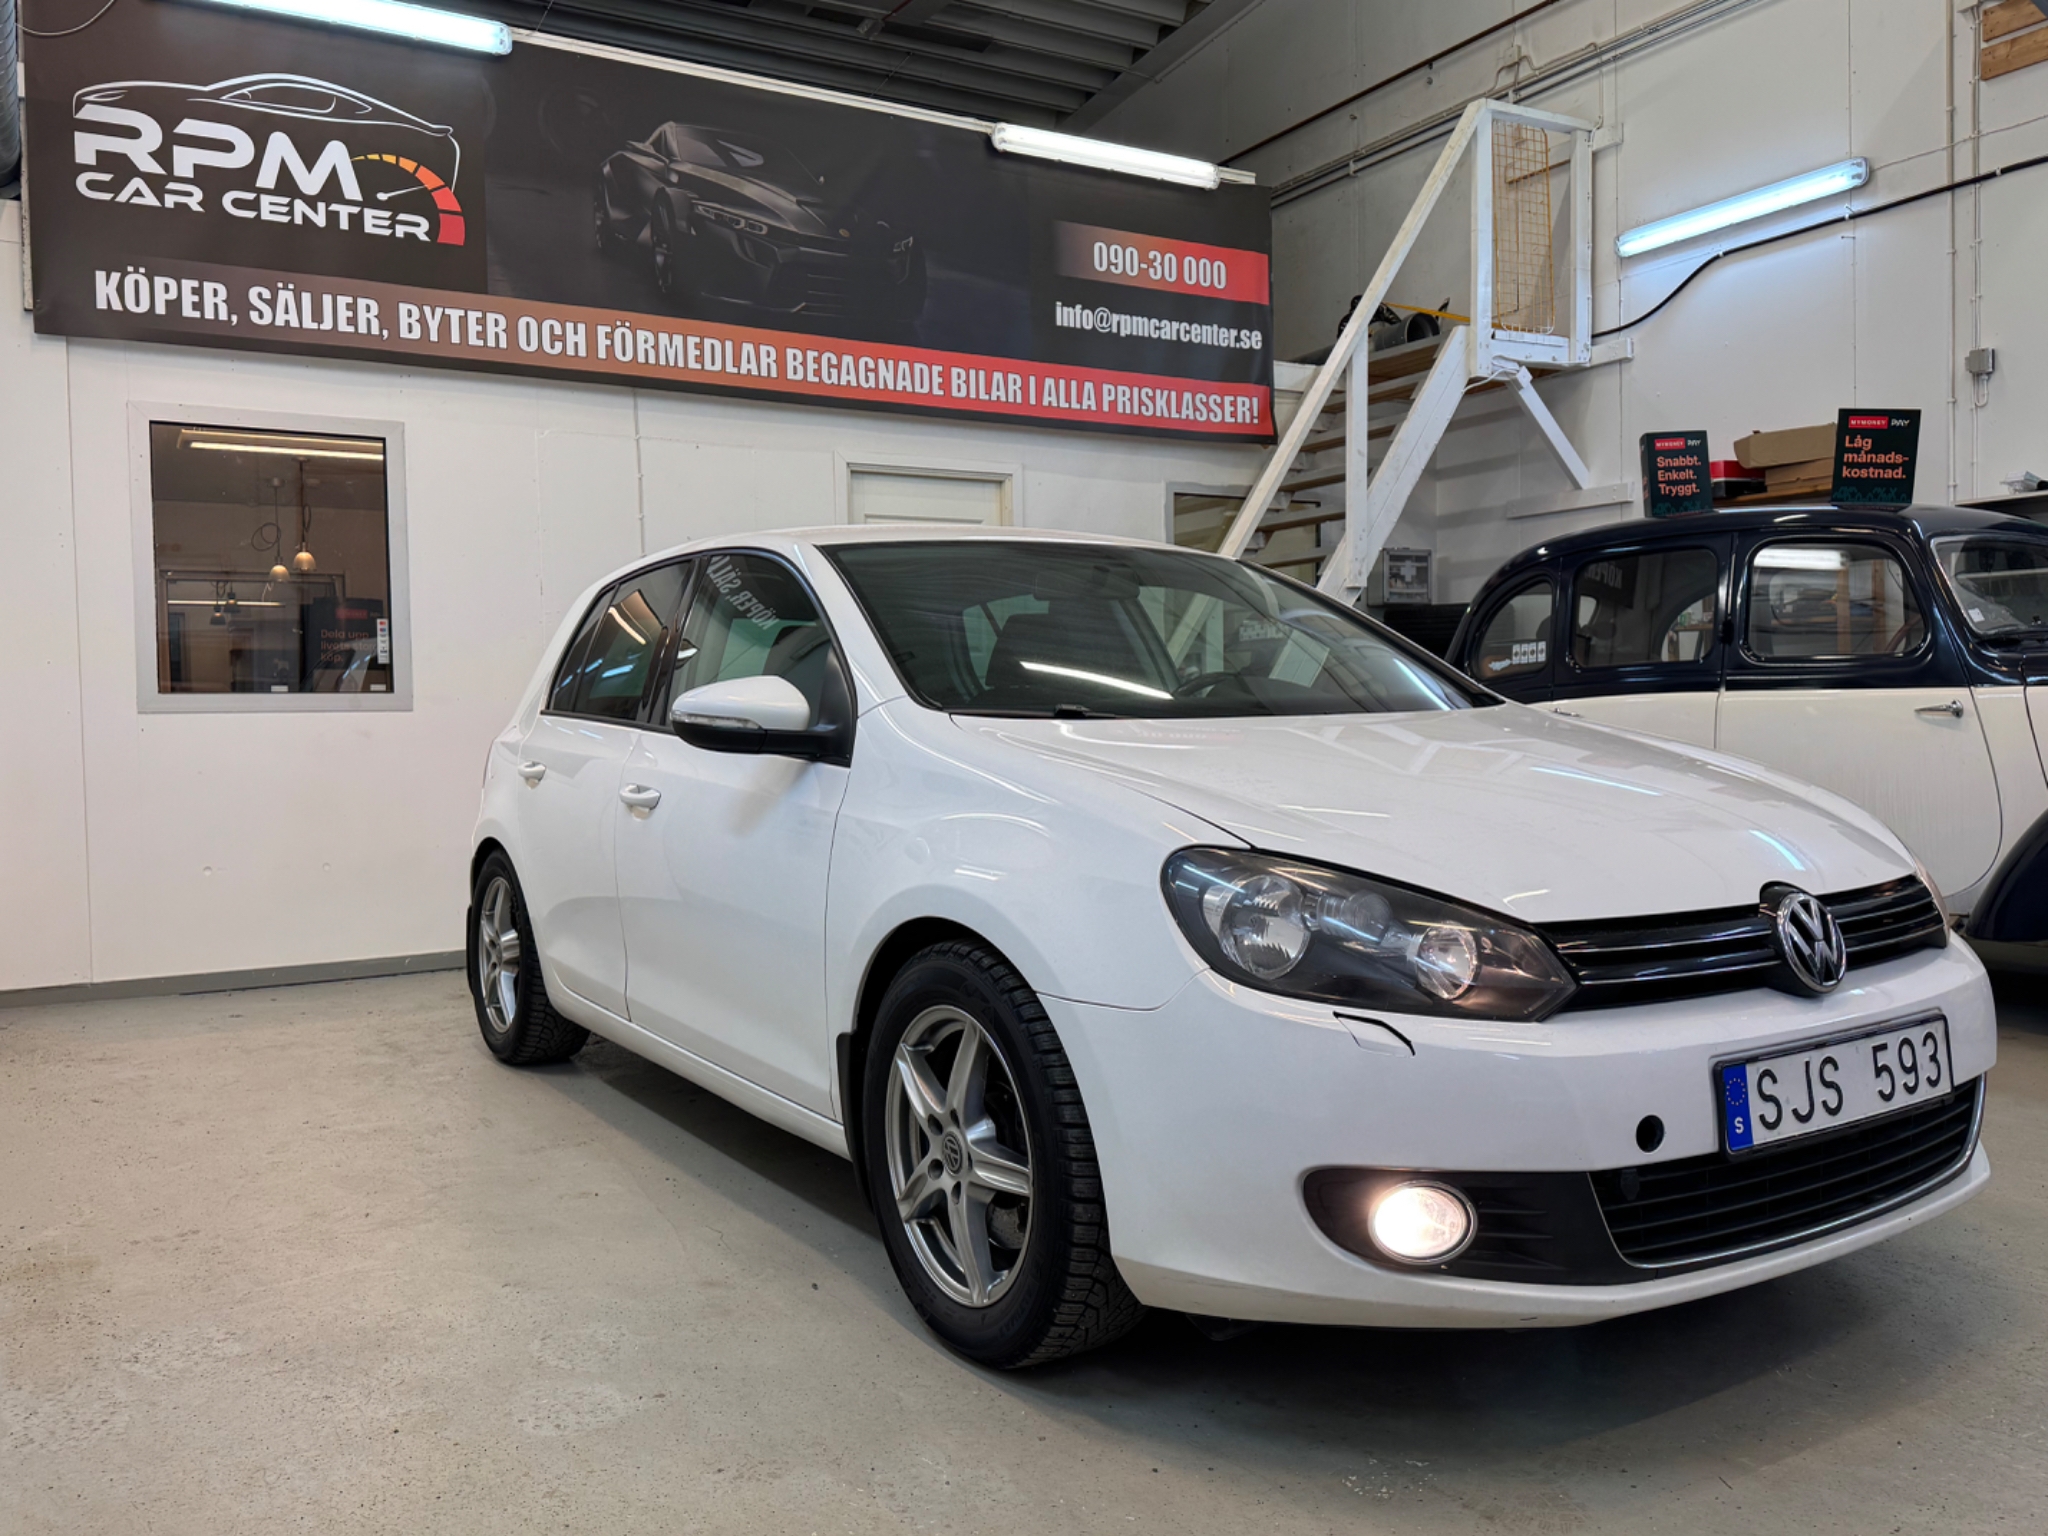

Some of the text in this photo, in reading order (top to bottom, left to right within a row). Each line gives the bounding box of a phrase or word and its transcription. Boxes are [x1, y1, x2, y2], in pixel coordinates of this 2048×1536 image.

[74, 104, 363, 201] RPM
[75, 172, 430, 241] CAR CENTER
[1093, 241, 1226, 289] 090-30 000
[1056, 302, 1262, 349] info@rpmcarcenter.se
[95, 265, 1259, 424] KÖPER, SÄLJER, BYTER OCH FÖRMEDLAR BEGAGNADE BILAR I ALLA PRISKLASSER!
[1844, 450, 1909, 464] månads-
[1845, 434, 1872, 451] Låg
[1657, 455, 1701, 468] Snabbt.
[1658, 469, 1697, 482] Enkelt.
[1842, 466, 1906, 479] kostnad.
[1658, 483, 1700, 497] Tryggt.
[1734, 1031, 1941, 1134] S SJS 593
